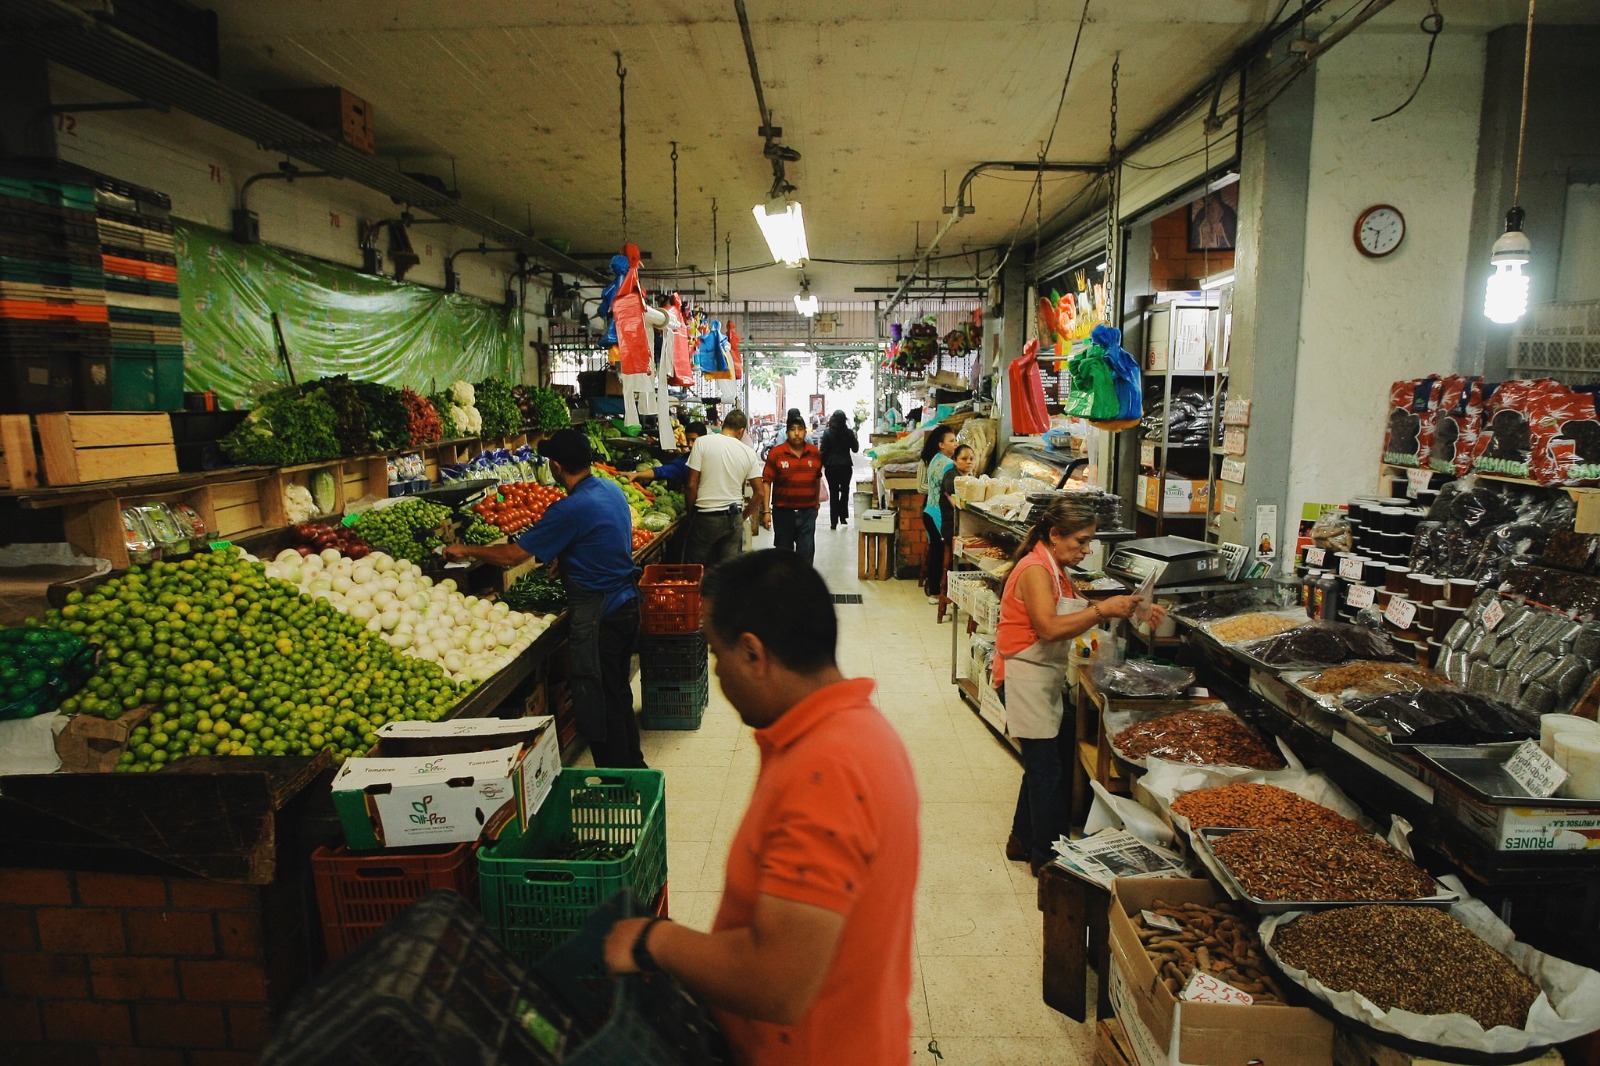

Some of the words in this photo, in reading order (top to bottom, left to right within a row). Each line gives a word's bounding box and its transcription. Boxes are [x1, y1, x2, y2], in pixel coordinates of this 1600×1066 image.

[54, 112, 77, 137] 72
[208, 164, 221, 185] 71
[329, 212, 340, 229] 70
[780, 460, 790, 469] 10
[1384, 450, 1419, 467] JAMAICA
[1474, 454, 1530, 479] JAMAICA
[1524, 742, 1541, 761] Pulpa
[1541, 757, 1552, 772] De
[1508, 762, 1525, 781] 100%
[1505, 836, 1555, 849] PRUNES
